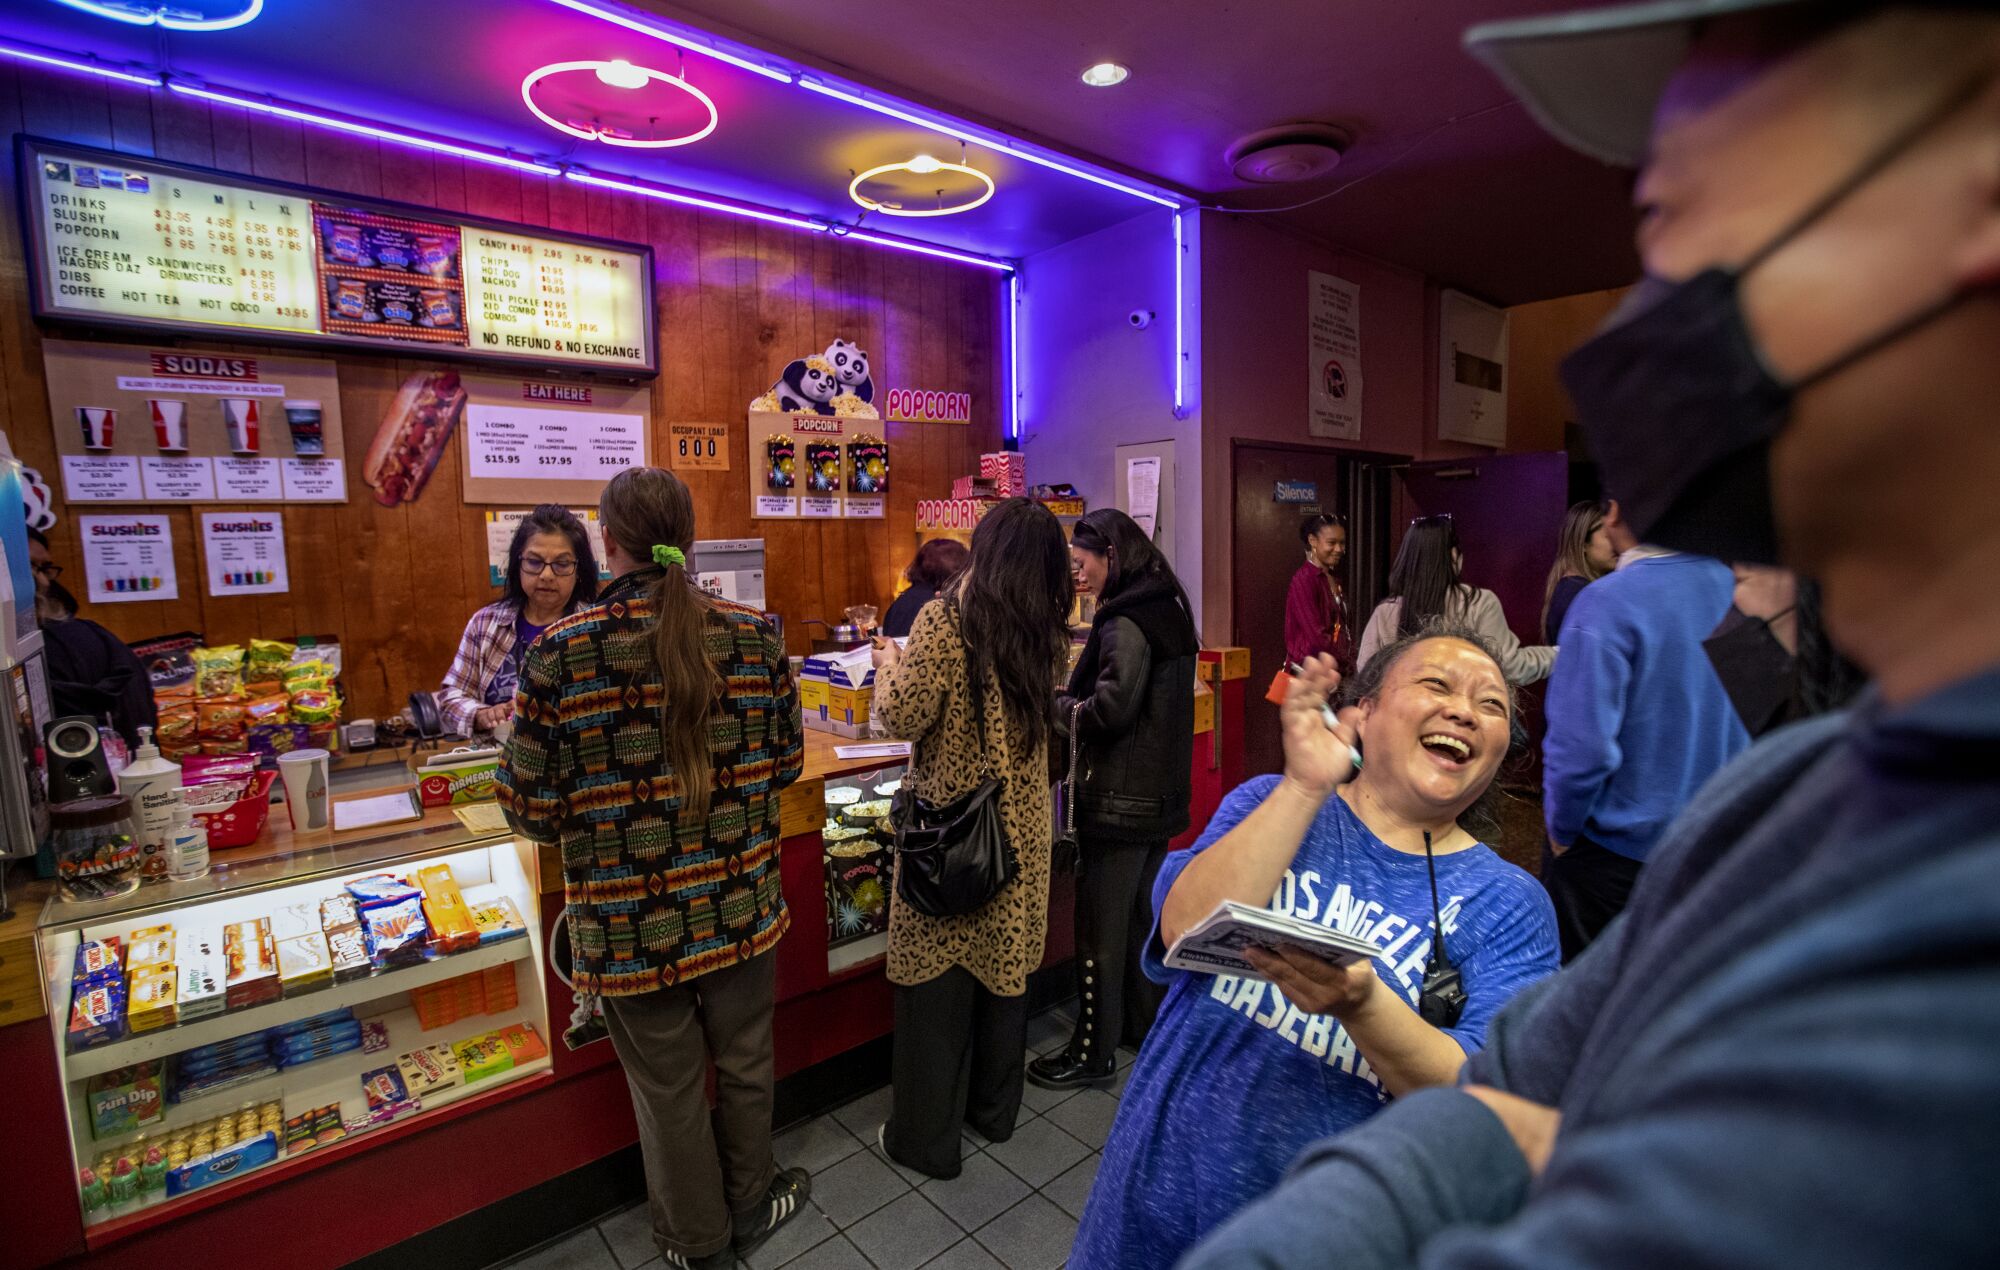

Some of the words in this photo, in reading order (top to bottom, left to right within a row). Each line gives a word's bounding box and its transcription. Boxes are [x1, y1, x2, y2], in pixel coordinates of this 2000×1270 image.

[51, 194, 106, 210] DRINKS
[173, 188, 181, 198] S
[214, 195, 223, 204] M
[248, 200, 255, 210] L
[280, 204, 291, 215] XL
[53, 208, 105, 223] SLUSHY
[56, 223, 119, 239] POPCORN
[480, 238, 507, 250] CANDY
[57, 245, 78, 257] ICE
[85, 249, 131, 262] CREAM
[147, 256, 226, 274] SANDWICHES
[481, 256, 509, 267] CHIPS
[59, 257, 109, 270] HAGENS
[116, 263, 141, 273] DAZ
[160, 270, 233, 286] DRUMSTICKS
[60, 270, 91, 282] DIBS
[482, 266, 498, 275] HOT
[503, 270, 520, 279] DOG
[482, 276, 517, 288] NACHOS
[60, 285, 105, 298] COFFEE
[122, 291, 146, 302] HOT
[156, 294, 180, 305] TEA
[200, 299, 222, 309] HOT
[231, 302, 260, 313] COCO
[483, 292, 503, 302] DILL
[508, 296, 540, 307] PICKLE
[483, 302, 499, 311] KID
[508, 305, 536, 316] COMBO
[483, 312, 517, 322] COMBOS
[483, 333, 498, 345] NO
[507, 334, 550, 349] REFUND
[555, 340, 563, 351] &
[566, 341, 581, 353] NO
[585, 343, 640, 358] EXCHANGE
[165, 356, 246, 376] SODAS
[530, 385, 551, 399] EAT
[555, 386, 585, 401] HERE
[888, 389, 971, 421] POPCORN
[672, 426, 705, 435] OCCUPANT
[709, 427, 725, 436] LOAD
[798, 420, 838, 432] POPCORN
[680, 439, 715, 456] 800
[485, 454, 520, 464] $15.95
[539, 456, 572, 465] $17.95
[599, 457, 630, 465] $18.95
[1277, 482, 1315, 500] Silence
[91, 521, 160, 536] SLUSHIES
[212, 518, 273, 532] SLUSHIES
[448, 770, 496, 794] AIRHEADS
[142, 792, 168, 802] Hand
[843, 864, 878, 880] POPCORN
[88, 948, 102, 971] CRUNCH
[92, 991, 107, 1016] CRUNCH
[96, 1097, 127, 1116] Fun
[128, 1089, 156, 1104] Dip
[209, 1154, 243, 1171] OREO
